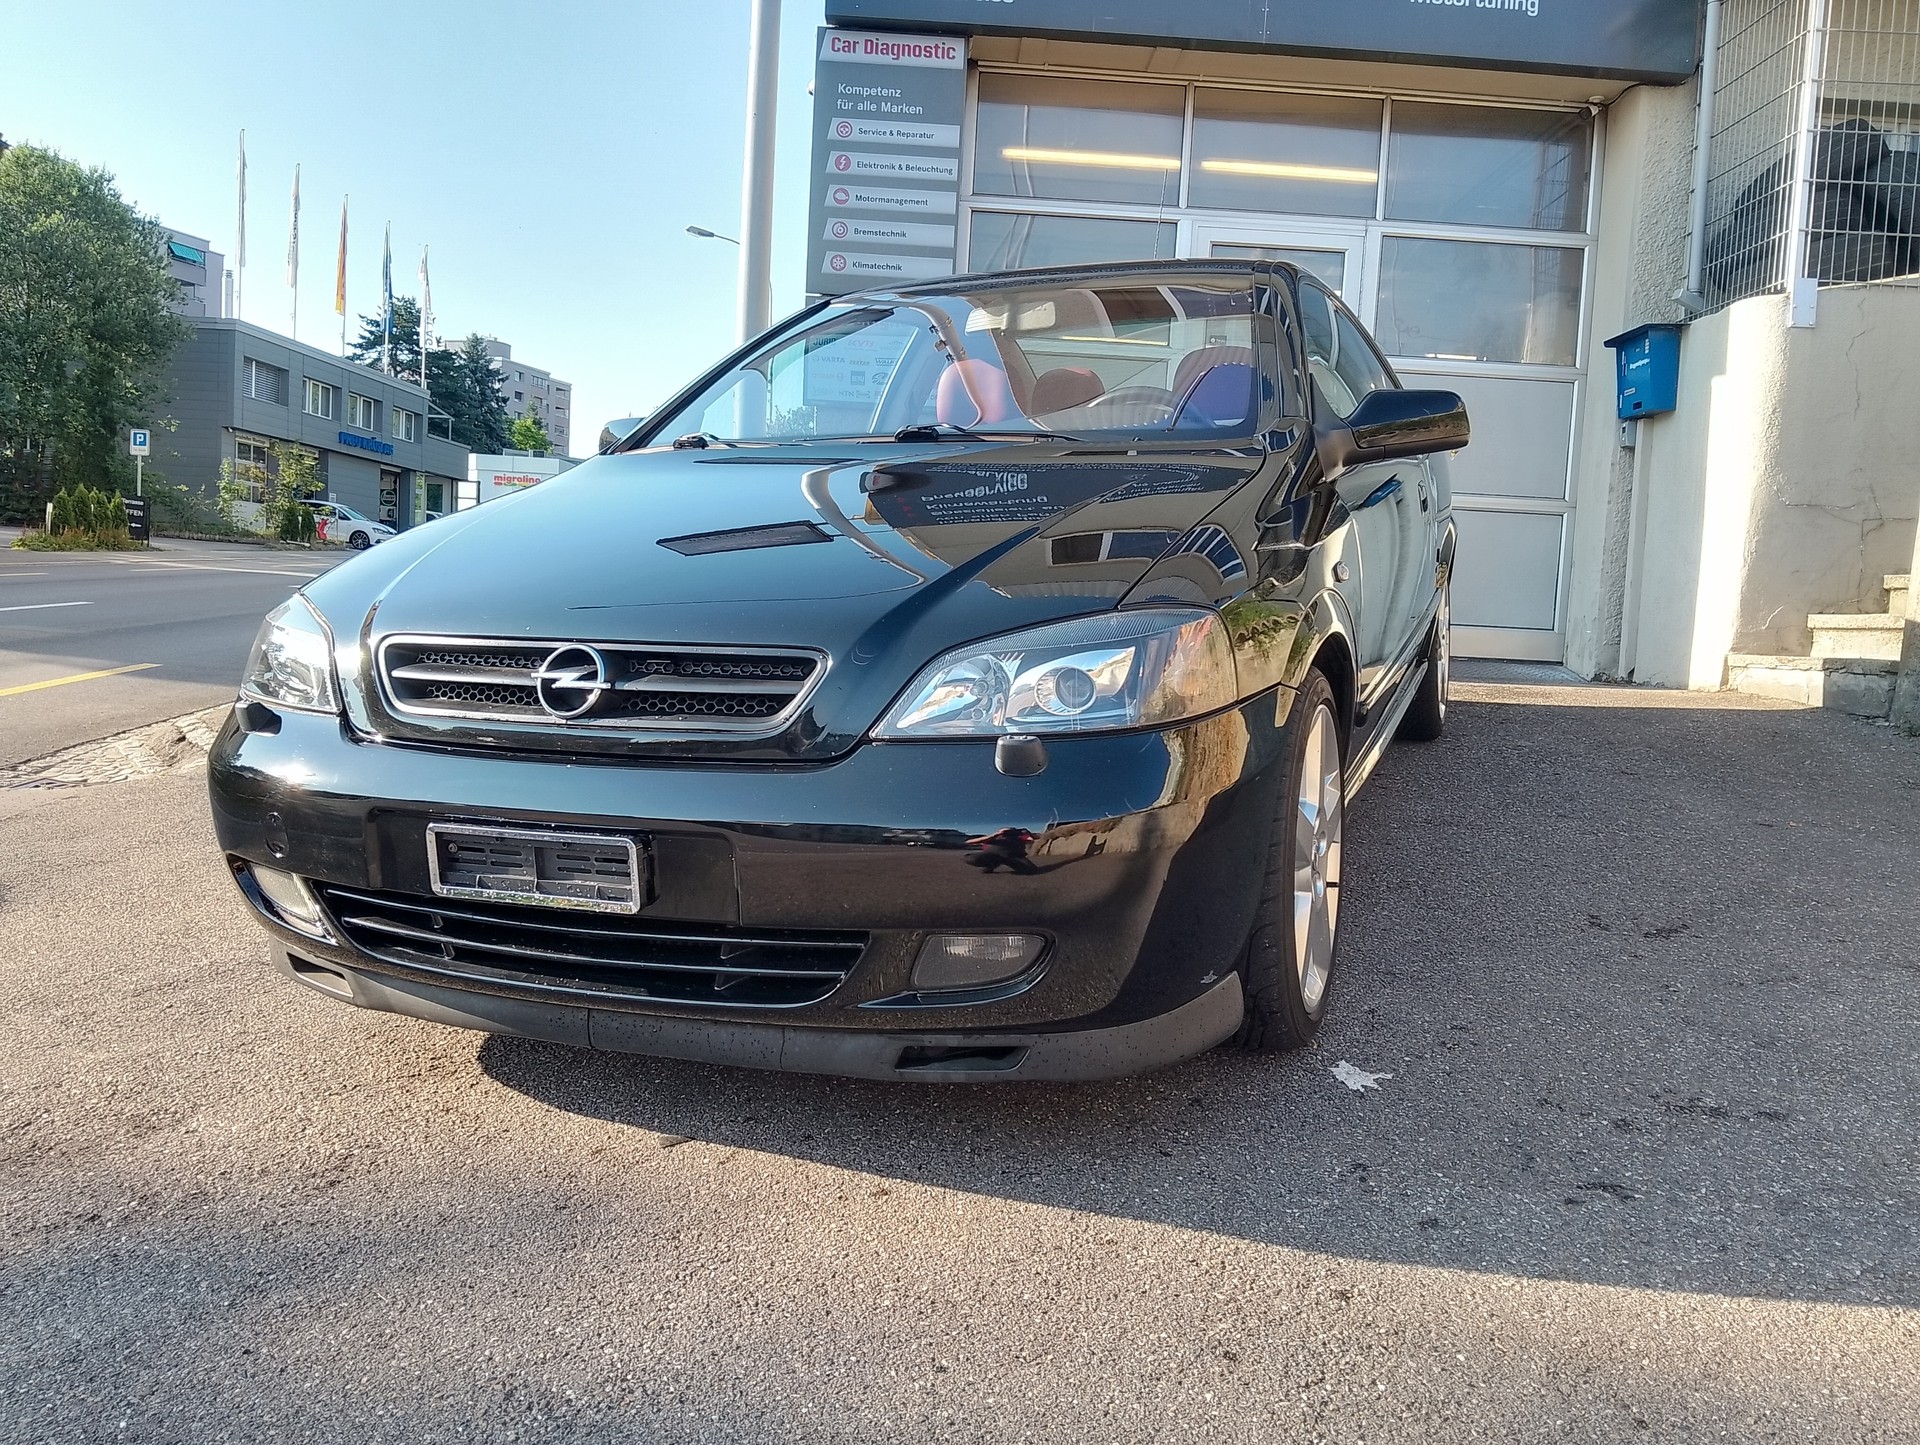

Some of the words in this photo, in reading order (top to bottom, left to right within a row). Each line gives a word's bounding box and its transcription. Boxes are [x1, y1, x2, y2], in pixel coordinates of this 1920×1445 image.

[1410, 0, 1539, 16] ortuning
[831, 36, 859, 54] Car
[863, 38, 956, 60] Diagnostic
[838, 83, 901, 97] Kompetenz
[837, 98, 854, 110] für
[857, 100, 877, 112] alle
[881, 102, 923, 115] Marken
[858, 127, 887, 136] Service
[896, 130, 935, 140] Reparatur
[856, 160, 896, 171] Elektronik
[905, 164, 953, 175] Beleuchtung
[855, 194, 928, 206] Motormanagement
[853, 227, 907, 238] Bremstechnik
[852, 260, 903, 271] Klimatechnik
[821, 356, 845, 364] VARTA
[136, 434, 144, 445] P
[493, 474, 541, 484] migrolino
[126, 508, 144, 517] FFEN
